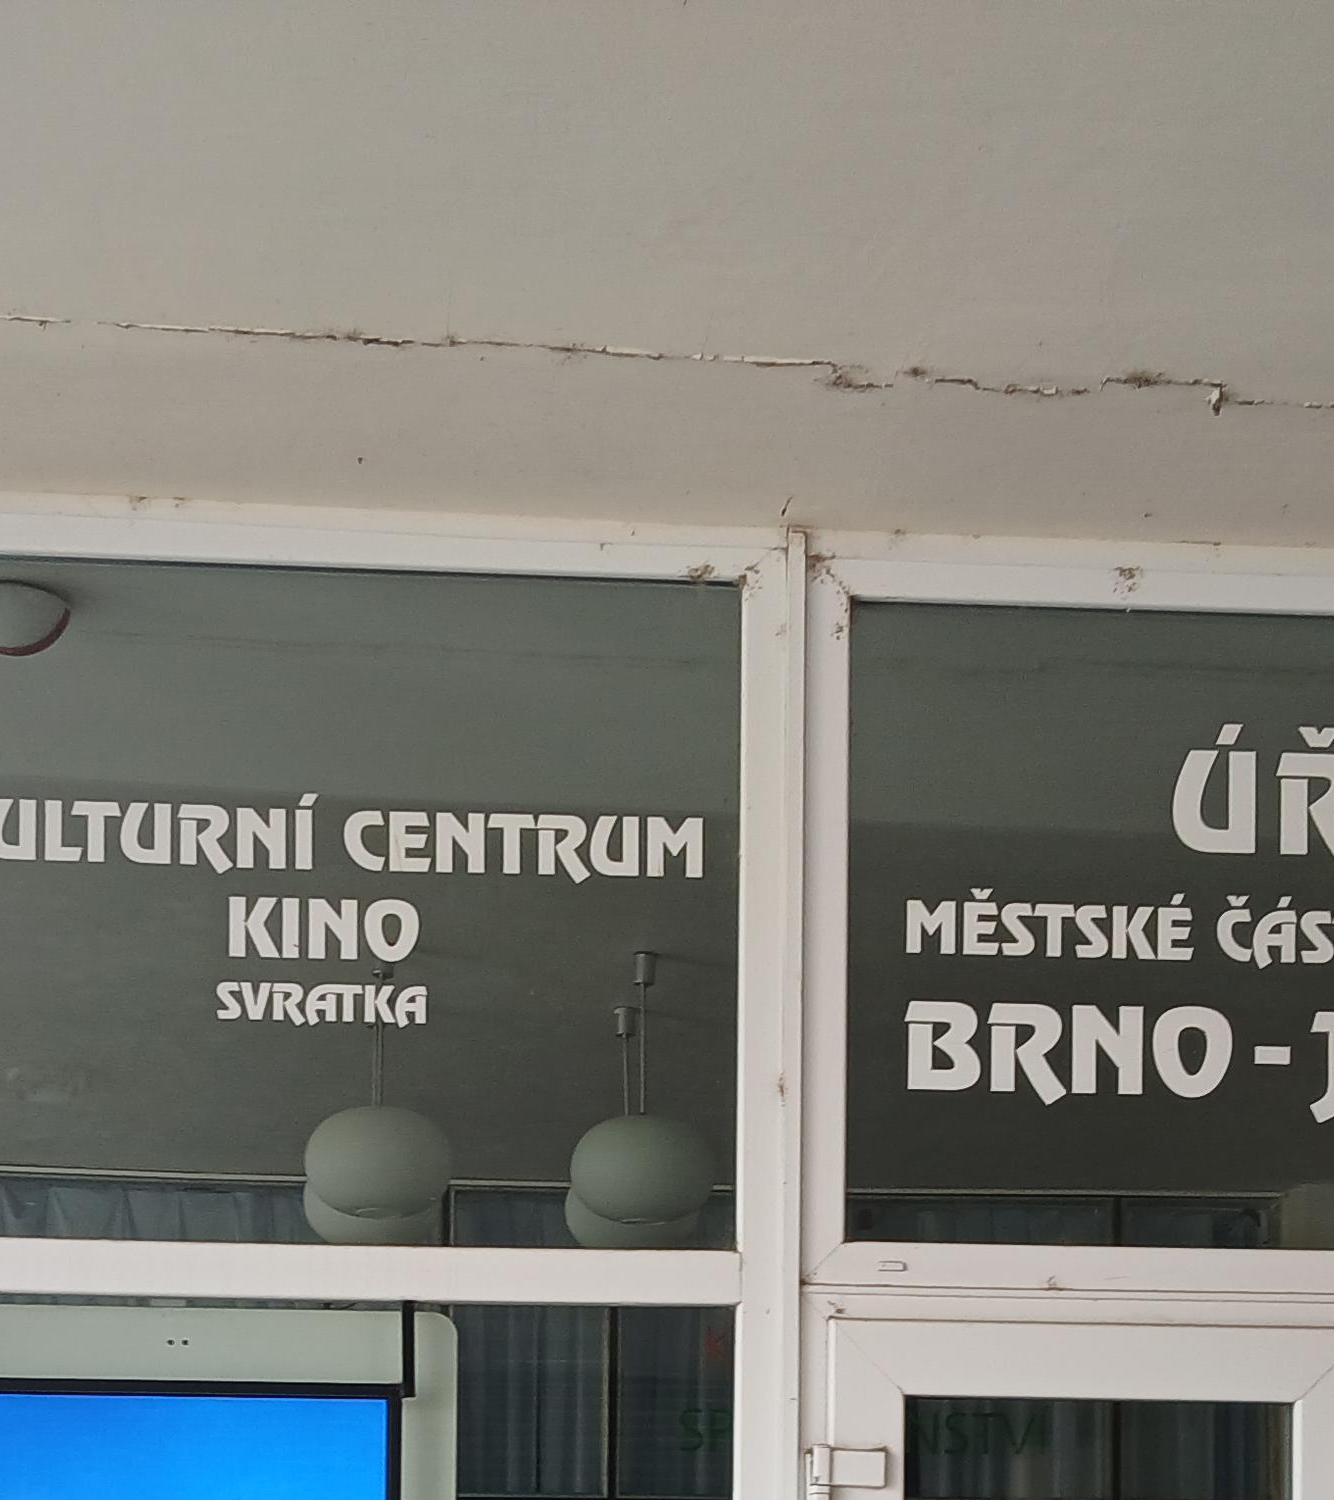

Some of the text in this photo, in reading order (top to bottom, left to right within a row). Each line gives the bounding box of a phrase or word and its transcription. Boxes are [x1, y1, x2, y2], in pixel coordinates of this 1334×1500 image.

[343, 810, 704, 884] CENTRUM
[228, 896, 420, 962] KINO
[906, 888, 1194, 961] MĚSTSKÉ
[216, 981, 428, 1028] SVRATKA
